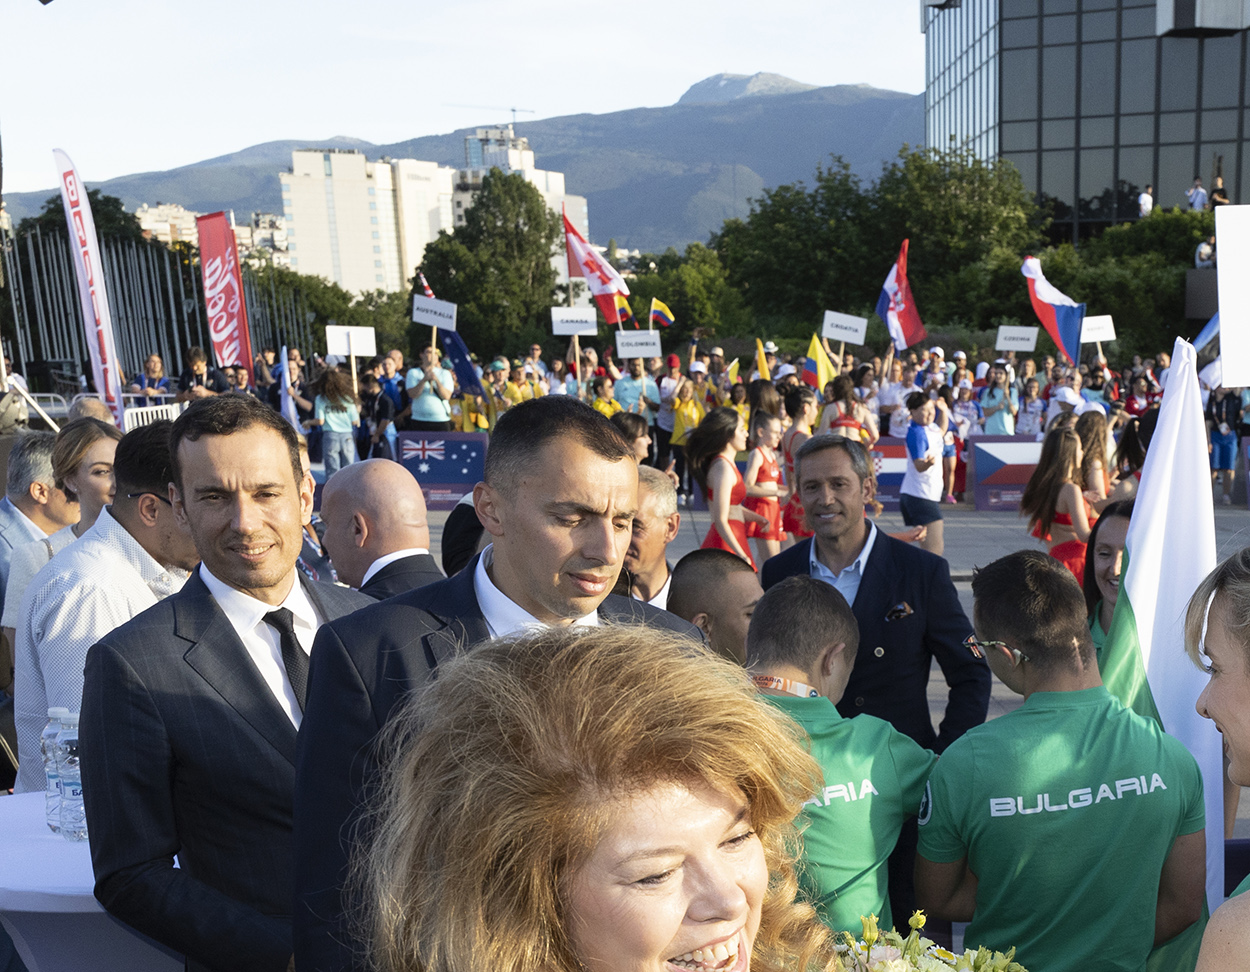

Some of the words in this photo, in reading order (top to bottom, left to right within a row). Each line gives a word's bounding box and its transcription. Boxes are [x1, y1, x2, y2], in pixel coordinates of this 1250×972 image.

[416, 306, 453, 320] AUSTRALIA
[801, 778, 879, 809] ARIA
[990, 772, 1167, 817] BULGARIA
